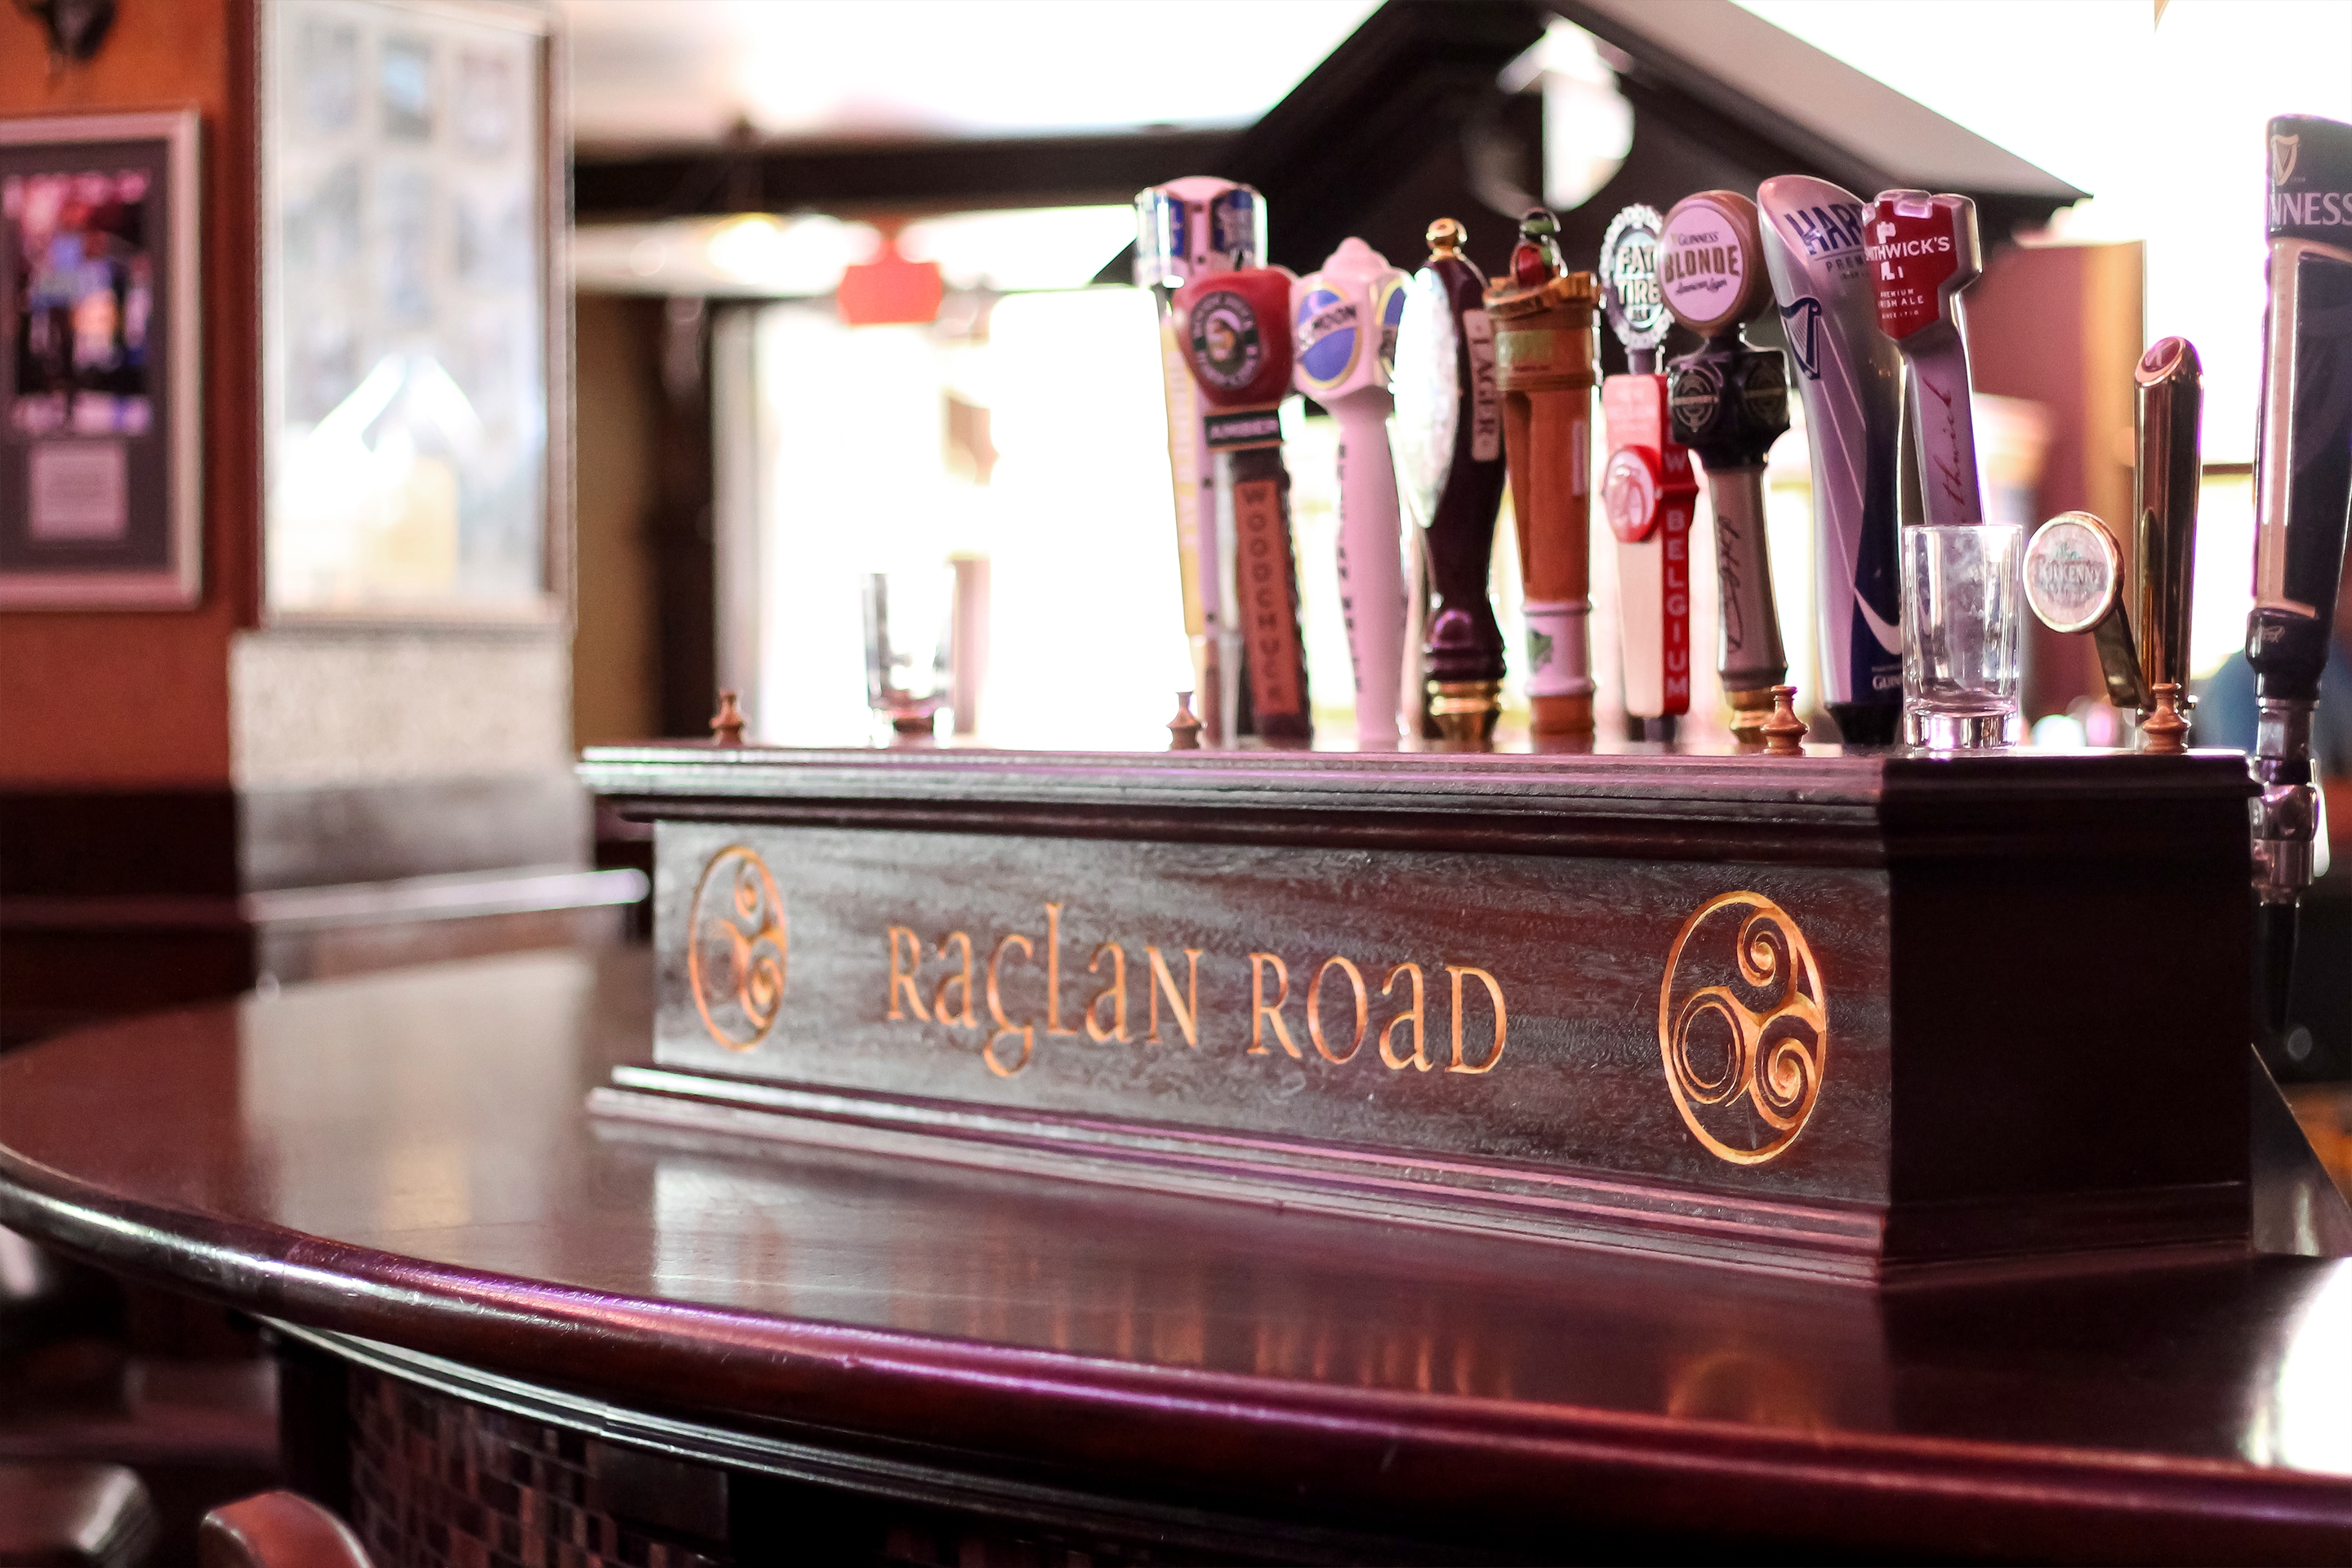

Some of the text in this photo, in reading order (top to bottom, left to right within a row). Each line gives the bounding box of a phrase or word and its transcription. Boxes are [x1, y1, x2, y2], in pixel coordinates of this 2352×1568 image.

[2268, 192, 2352, 225] NNESS
[1617, 246, 1655, 274] FAT
[1664, 244, 1740, 284] BLONDE
[1825, 255, 1865, 273] PREM
[1615, 278, 1661, 305] TIRE
[1900, 295, 1924, 305] ALE
[1665, 509, 1689, 696] BELGIUM
